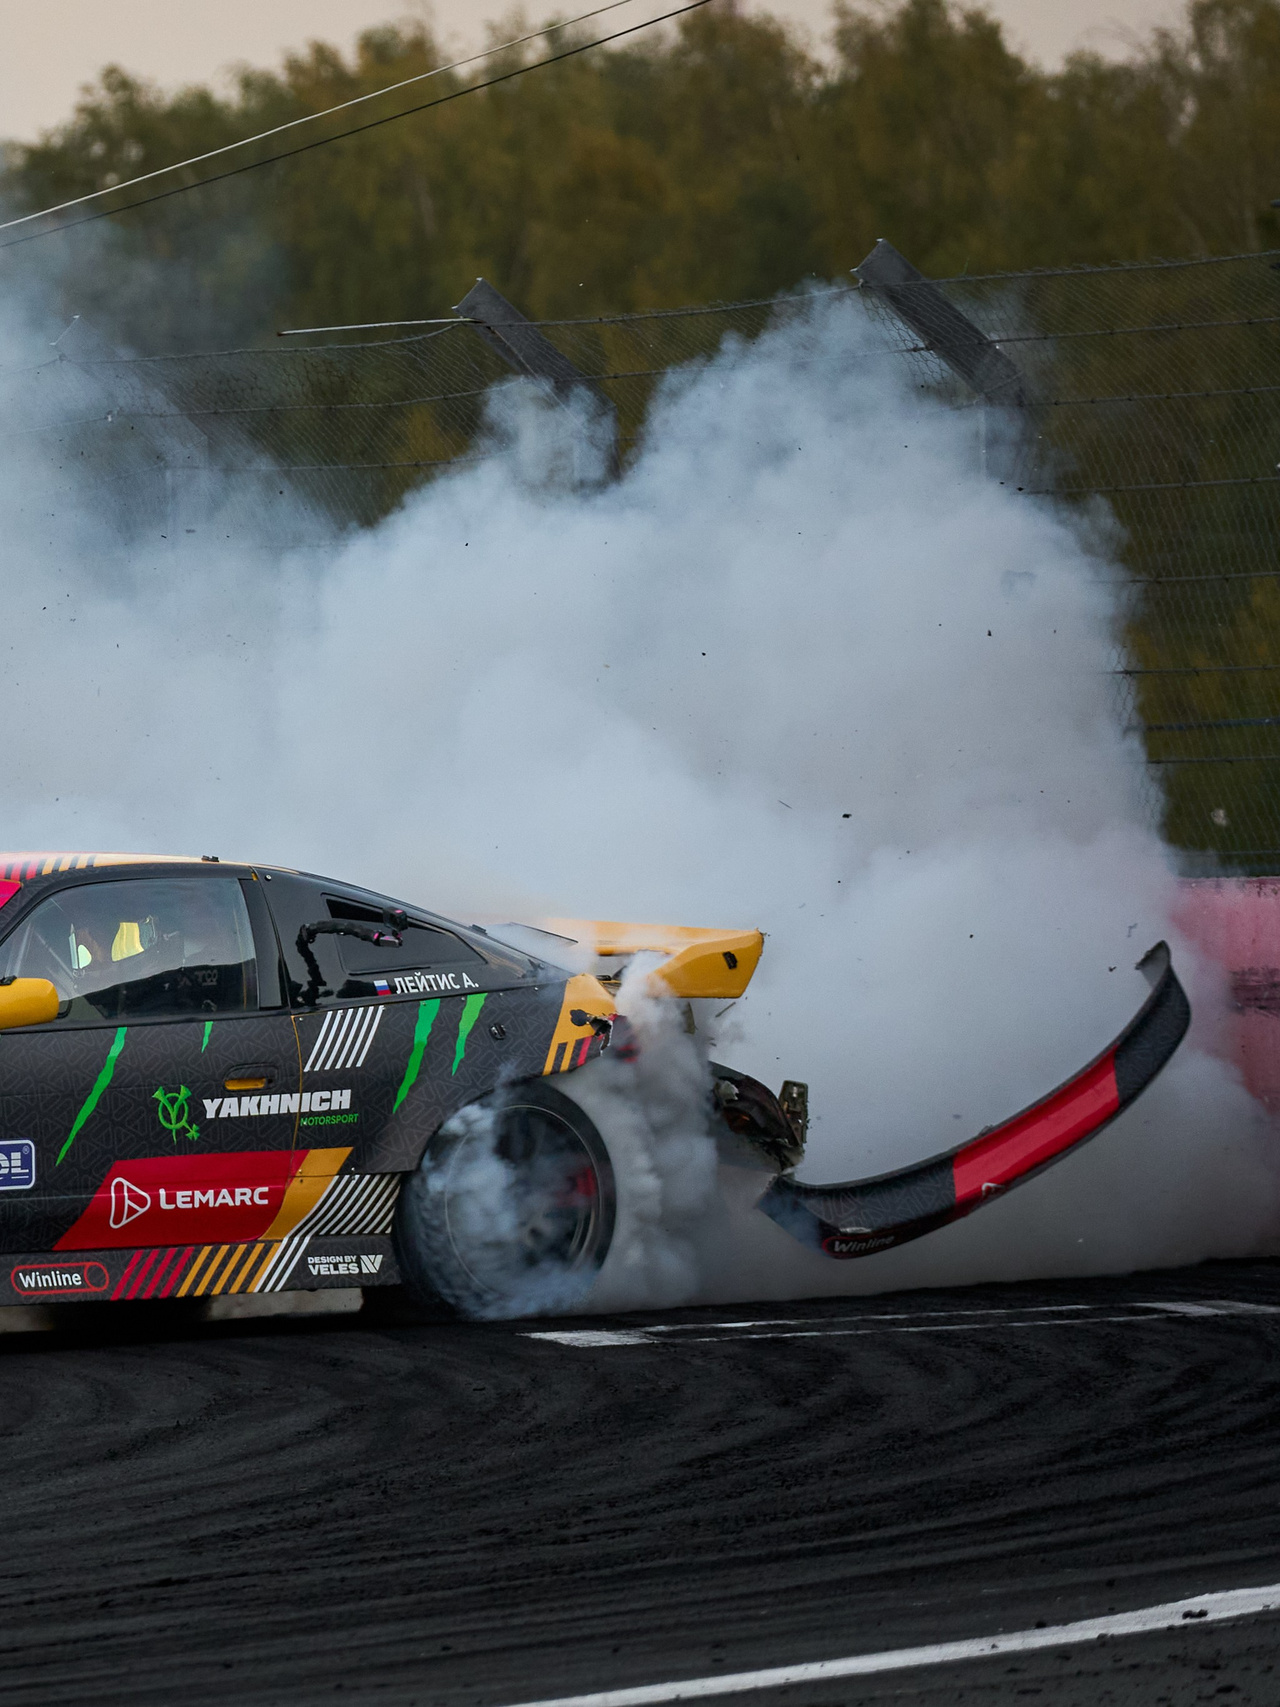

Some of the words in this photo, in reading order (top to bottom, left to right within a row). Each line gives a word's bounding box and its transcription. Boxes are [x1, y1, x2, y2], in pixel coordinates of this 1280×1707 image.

[394, 971, 461, 995] ЛЕЙТИС
[462, 972, 480, 988] А.
[202, 1088, 352, 1119] YAKHNICH
[300, 1113, 360, 1127] MOTORSPORT
[158, 1186, 270, 1210] LEMARC
[833, 1236, 895, 1252] Winline
[307, 1255, 344, 1264] DESIGN
[344, 1255, 357, 1263] BY
[308, 1263, 360, 1276] VELES
[19, 1271, 83, 1288] Winline
